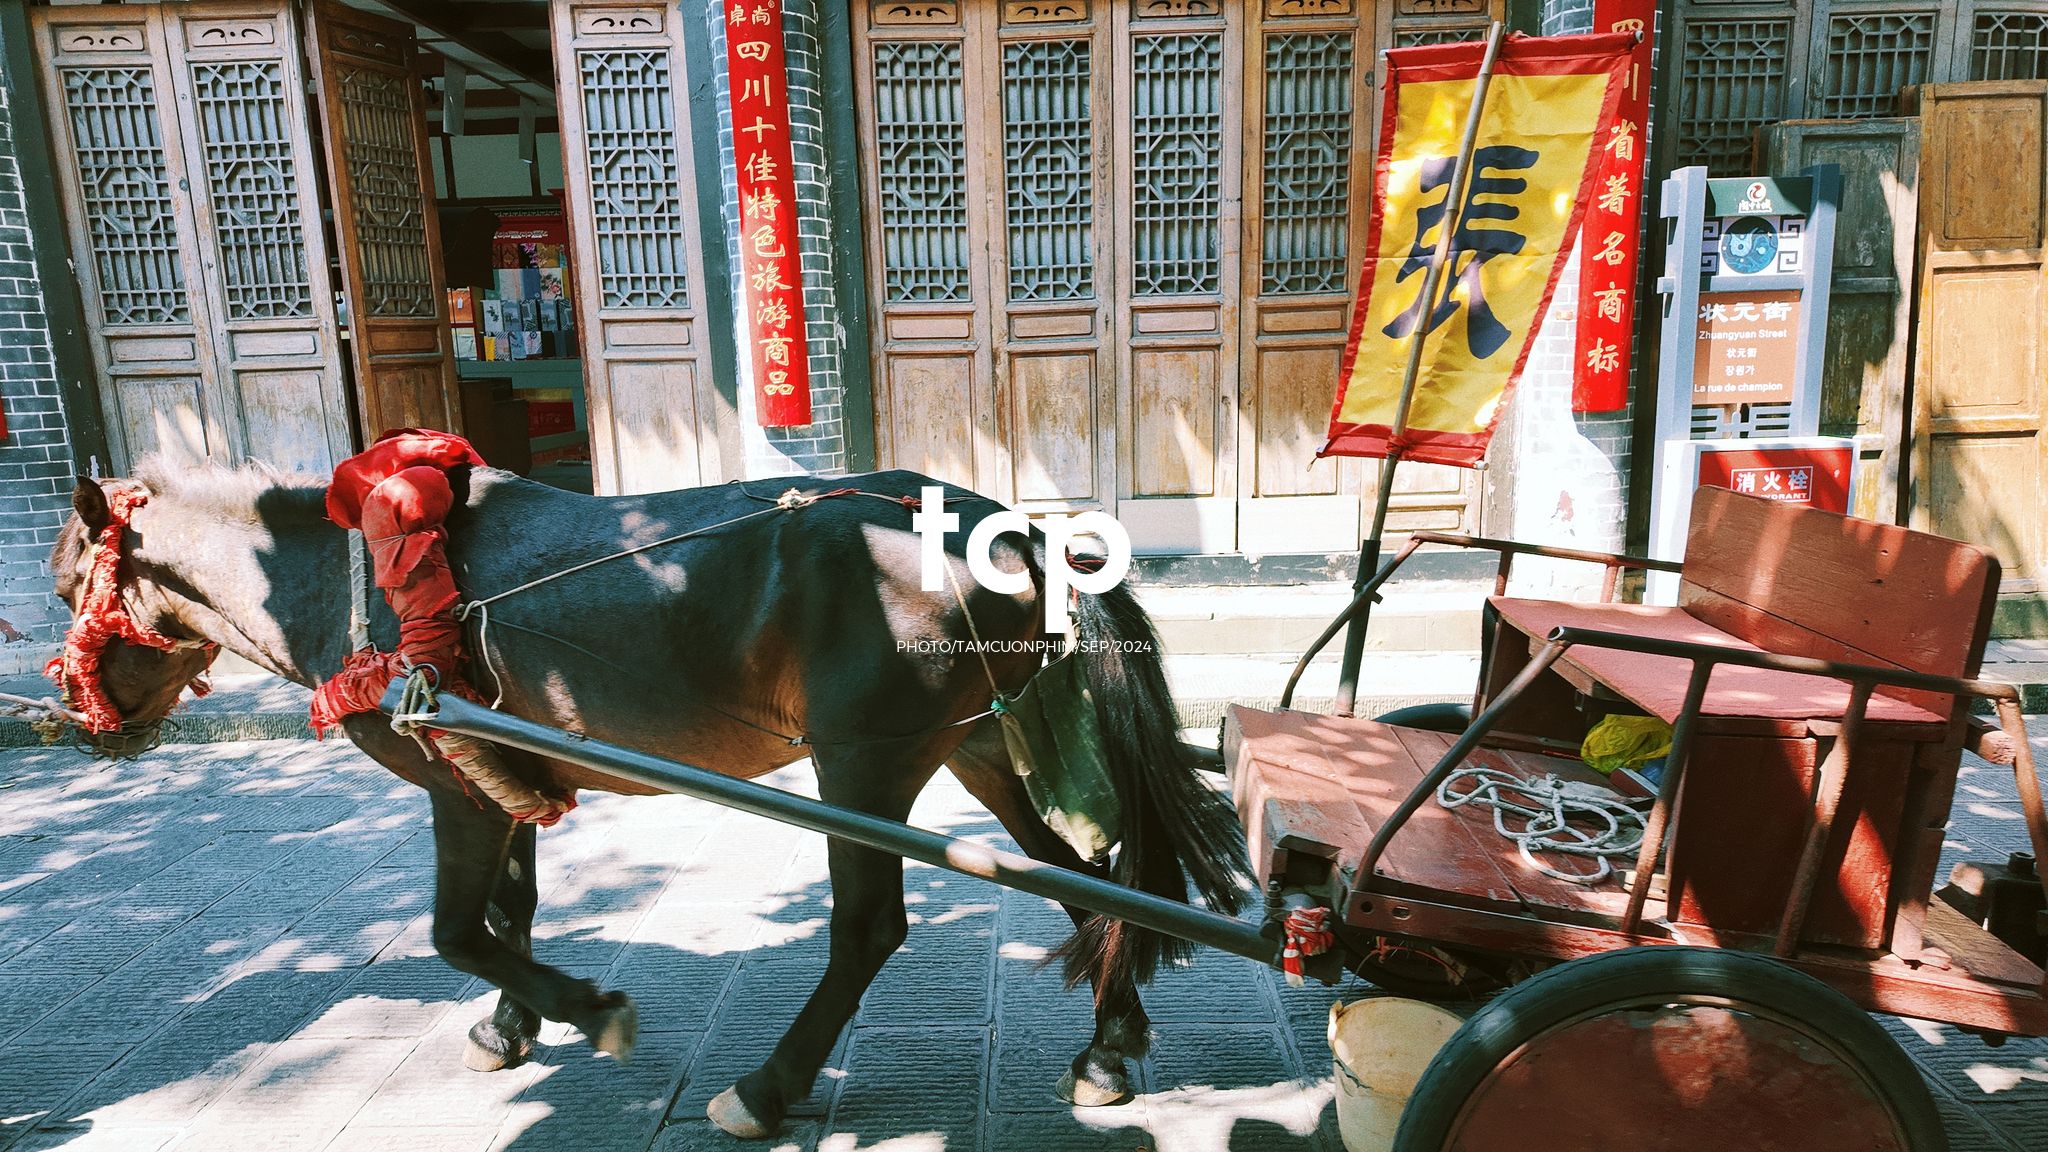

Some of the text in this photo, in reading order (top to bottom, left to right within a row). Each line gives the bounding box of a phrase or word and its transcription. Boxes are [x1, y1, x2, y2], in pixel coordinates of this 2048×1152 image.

[736, 41, 795, 396] 四川十佳特色旅游商品
[1699, 301, 1792, 322] 状元街
[1699, 329, 1787, 341] Zhuangyuan Street
[1694, 384, 1706, 392] La
[1724, 383, 1736, 392] de
[1737, 382, 1783, 393] champion
[1736, 470, 1808, 492] 消火栓
